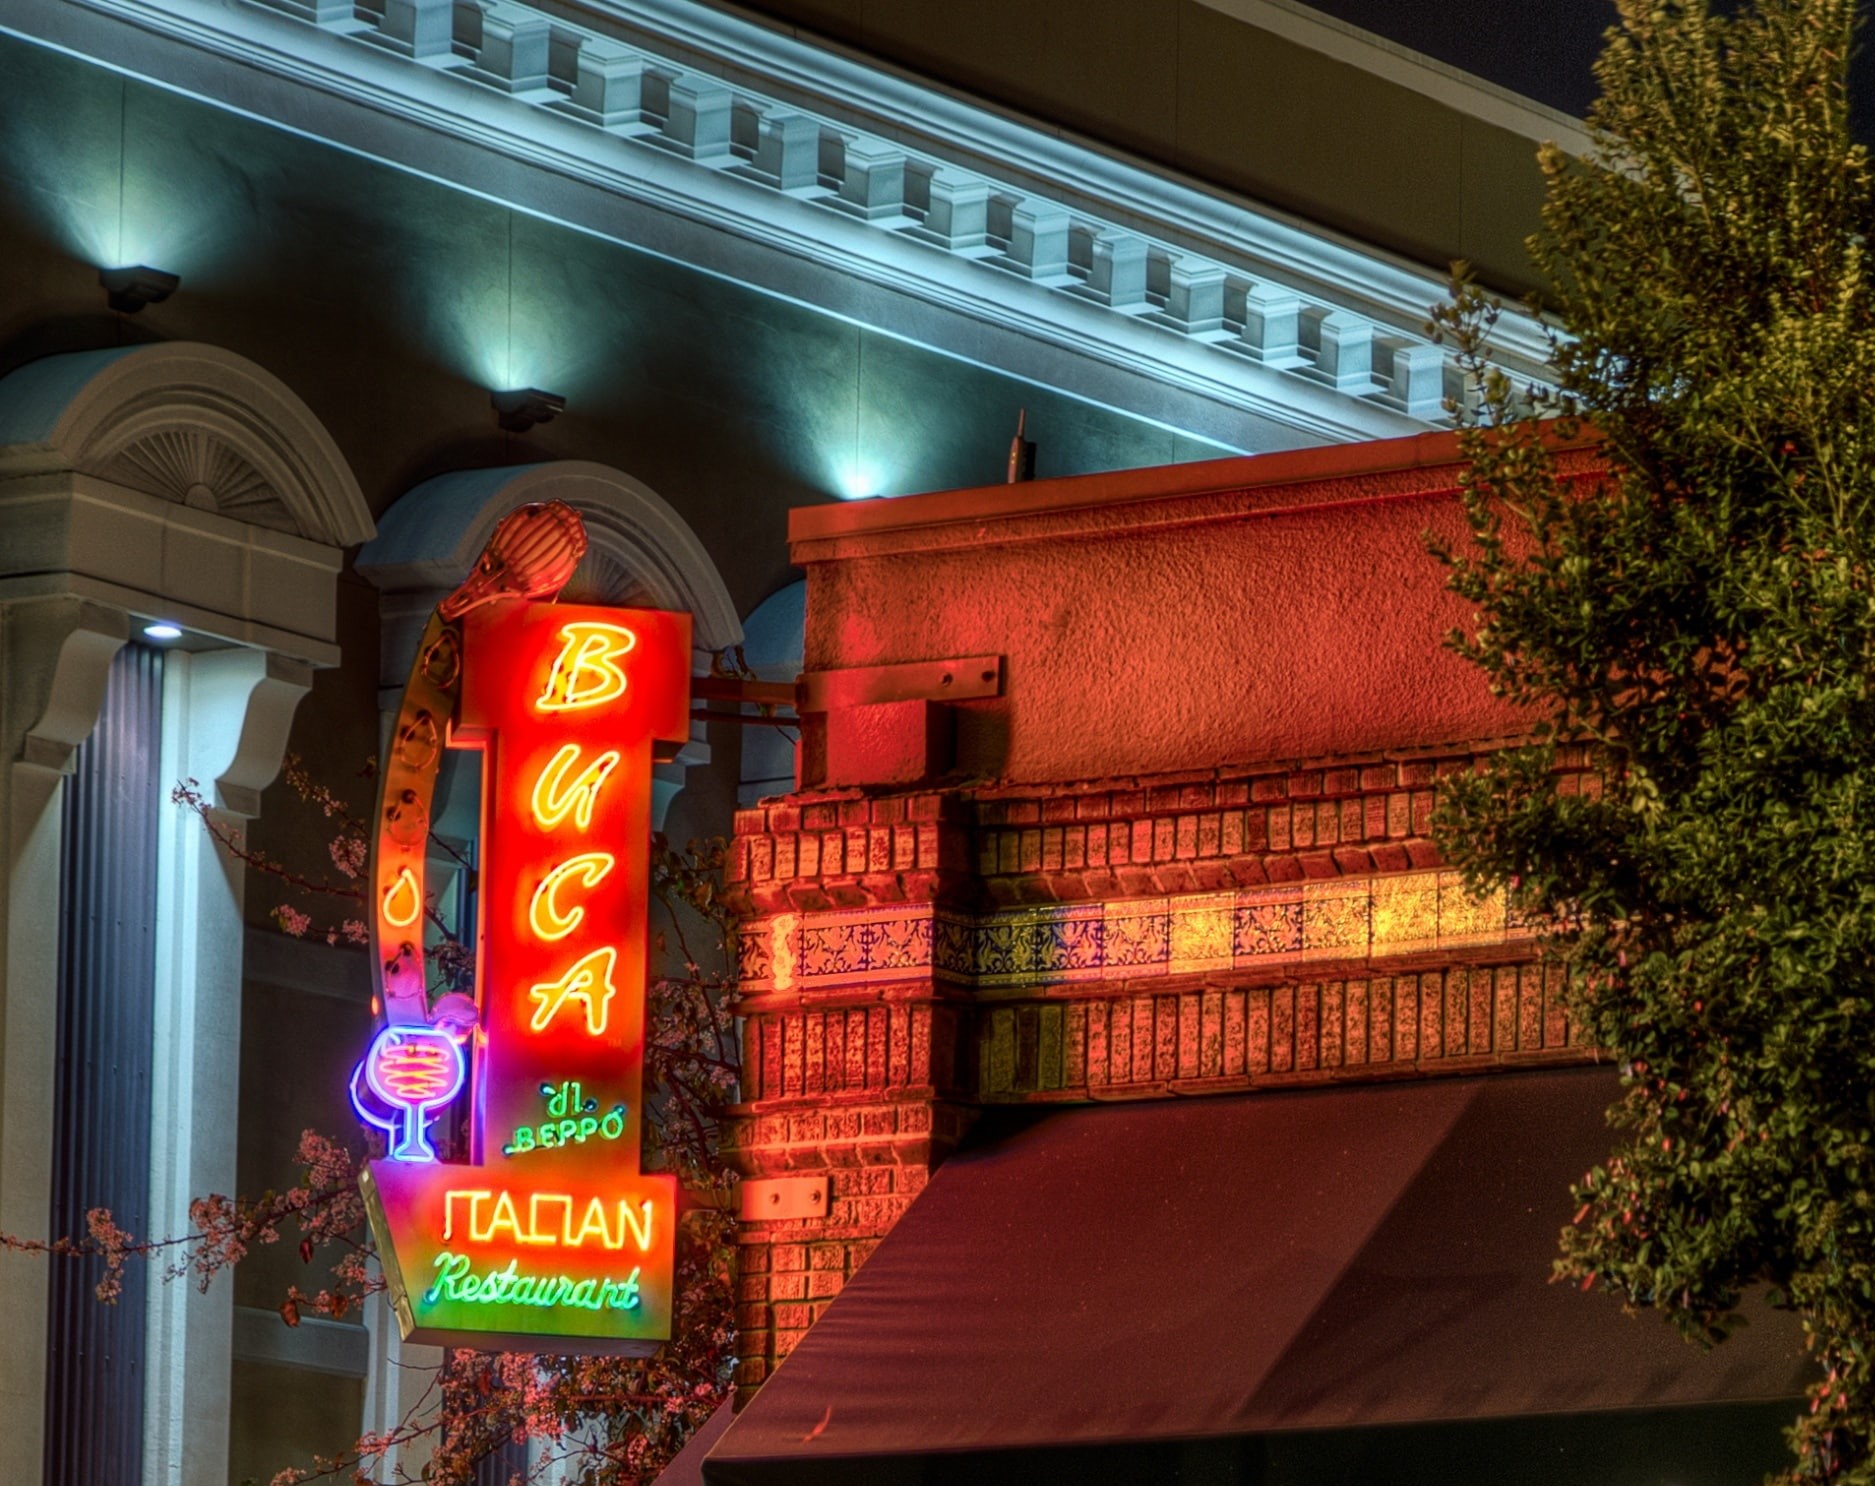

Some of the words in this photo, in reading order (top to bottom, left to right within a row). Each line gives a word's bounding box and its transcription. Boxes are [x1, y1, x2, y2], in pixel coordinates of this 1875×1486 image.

[530, 622, 636, 1035] BUCA
[504, 1109, 625, 1153] BEPPO
[442, 1190, 653, 1252] ITALIAN
[424, 1252, 641, 1311] Restaurant
